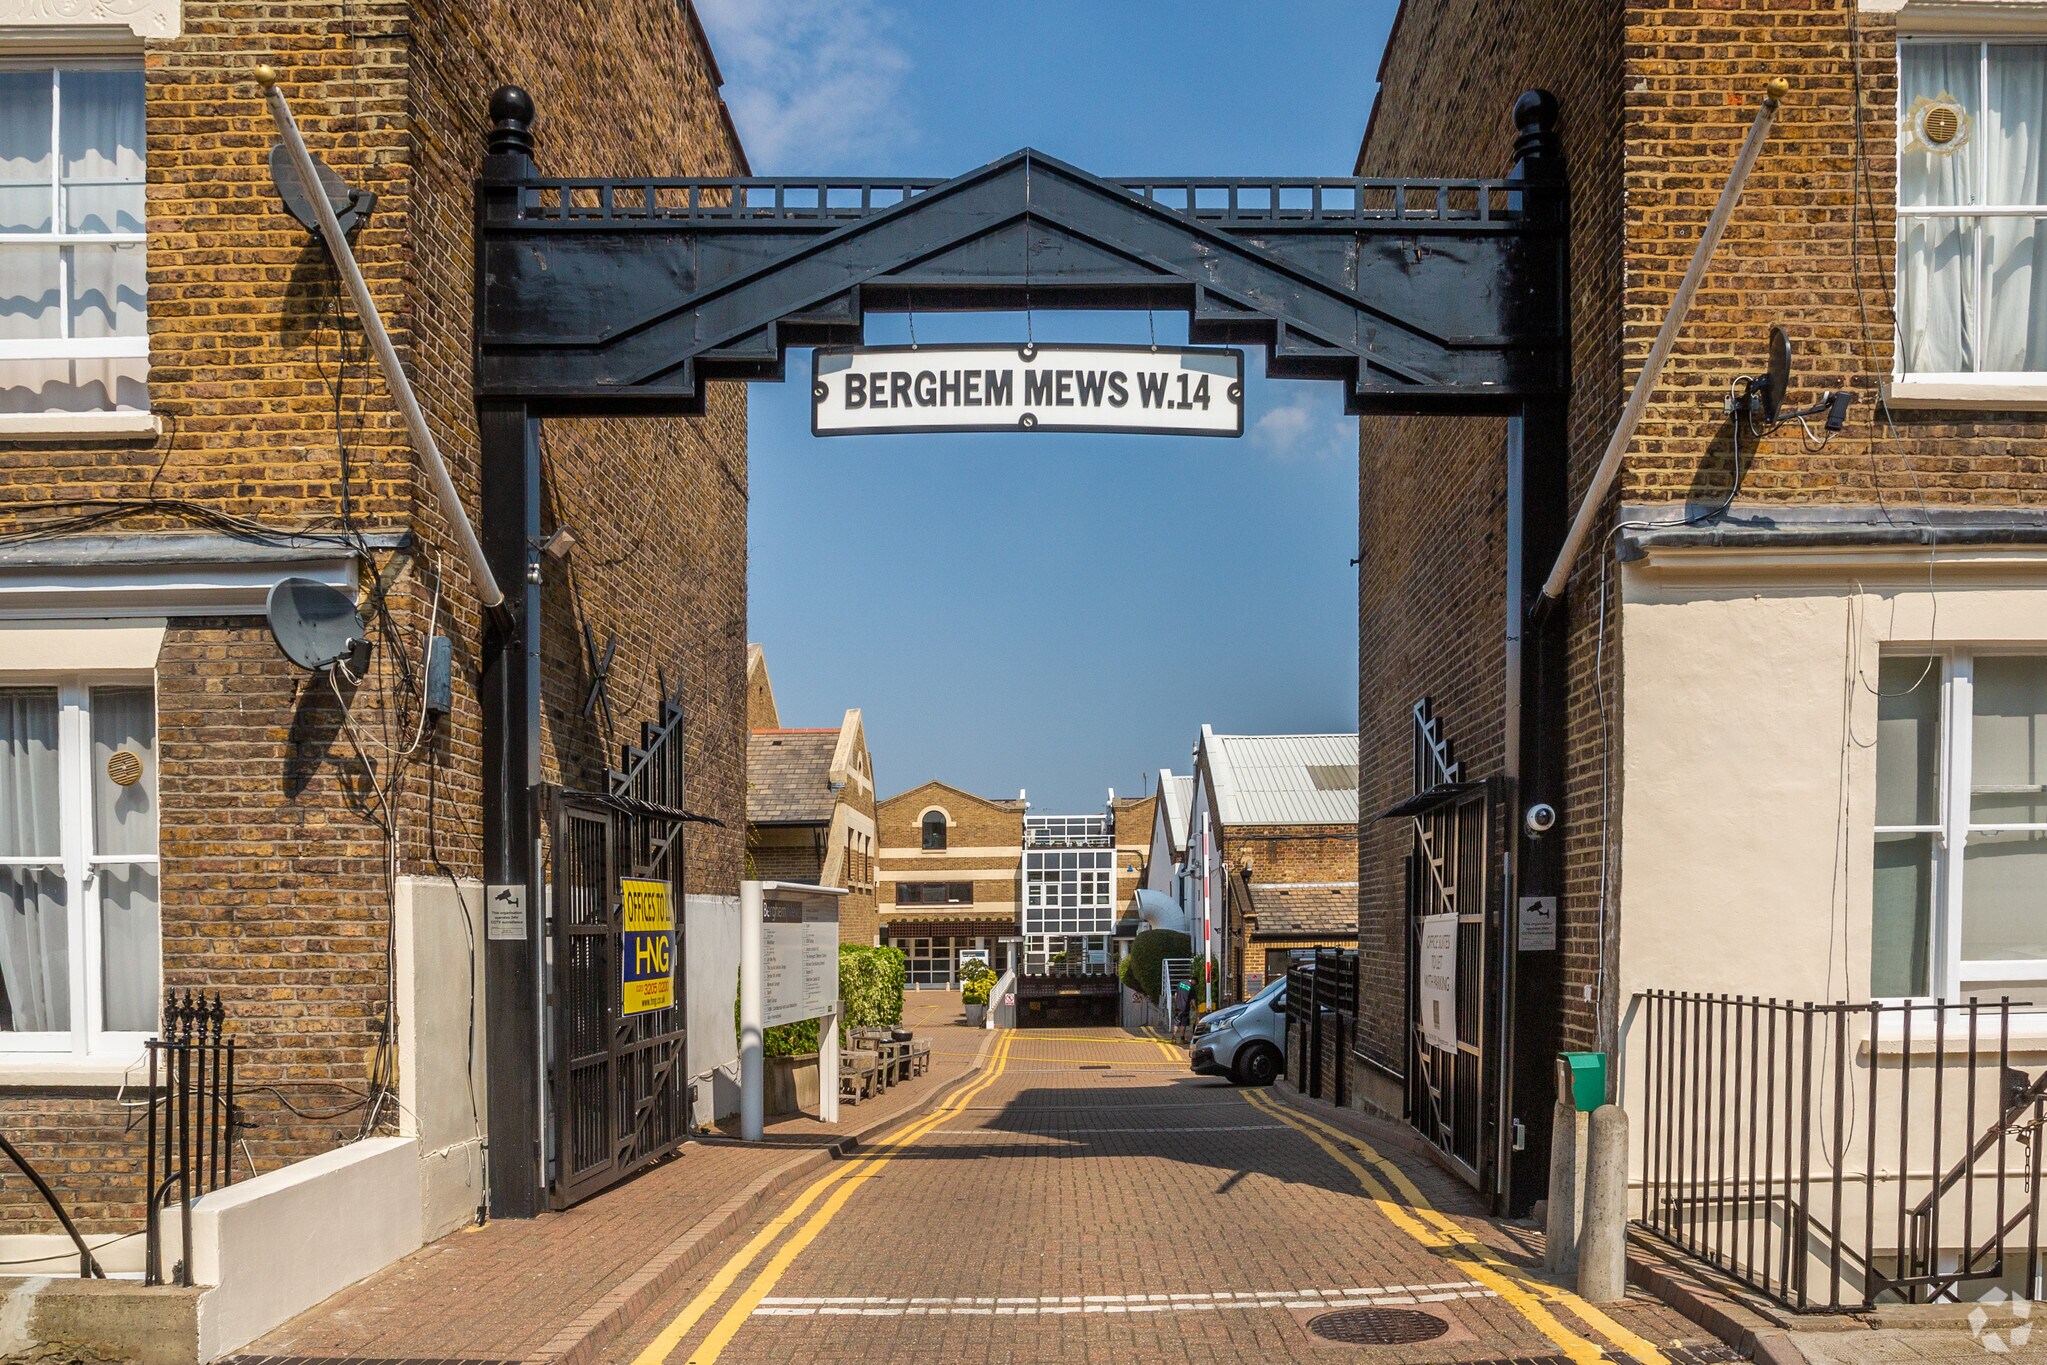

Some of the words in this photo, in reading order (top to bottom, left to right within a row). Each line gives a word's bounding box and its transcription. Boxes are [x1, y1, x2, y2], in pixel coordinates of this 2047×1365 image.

[844, 369, 1013, 410] BERGHEM
[1024, 369, 1129, 408] MEWS
[1138, 371, 1211, 411] W.14
[627, 891, 655, 922] OFFICES
[656, 892, 664, 922] TO
[635, 935, 669, 975] HNG
